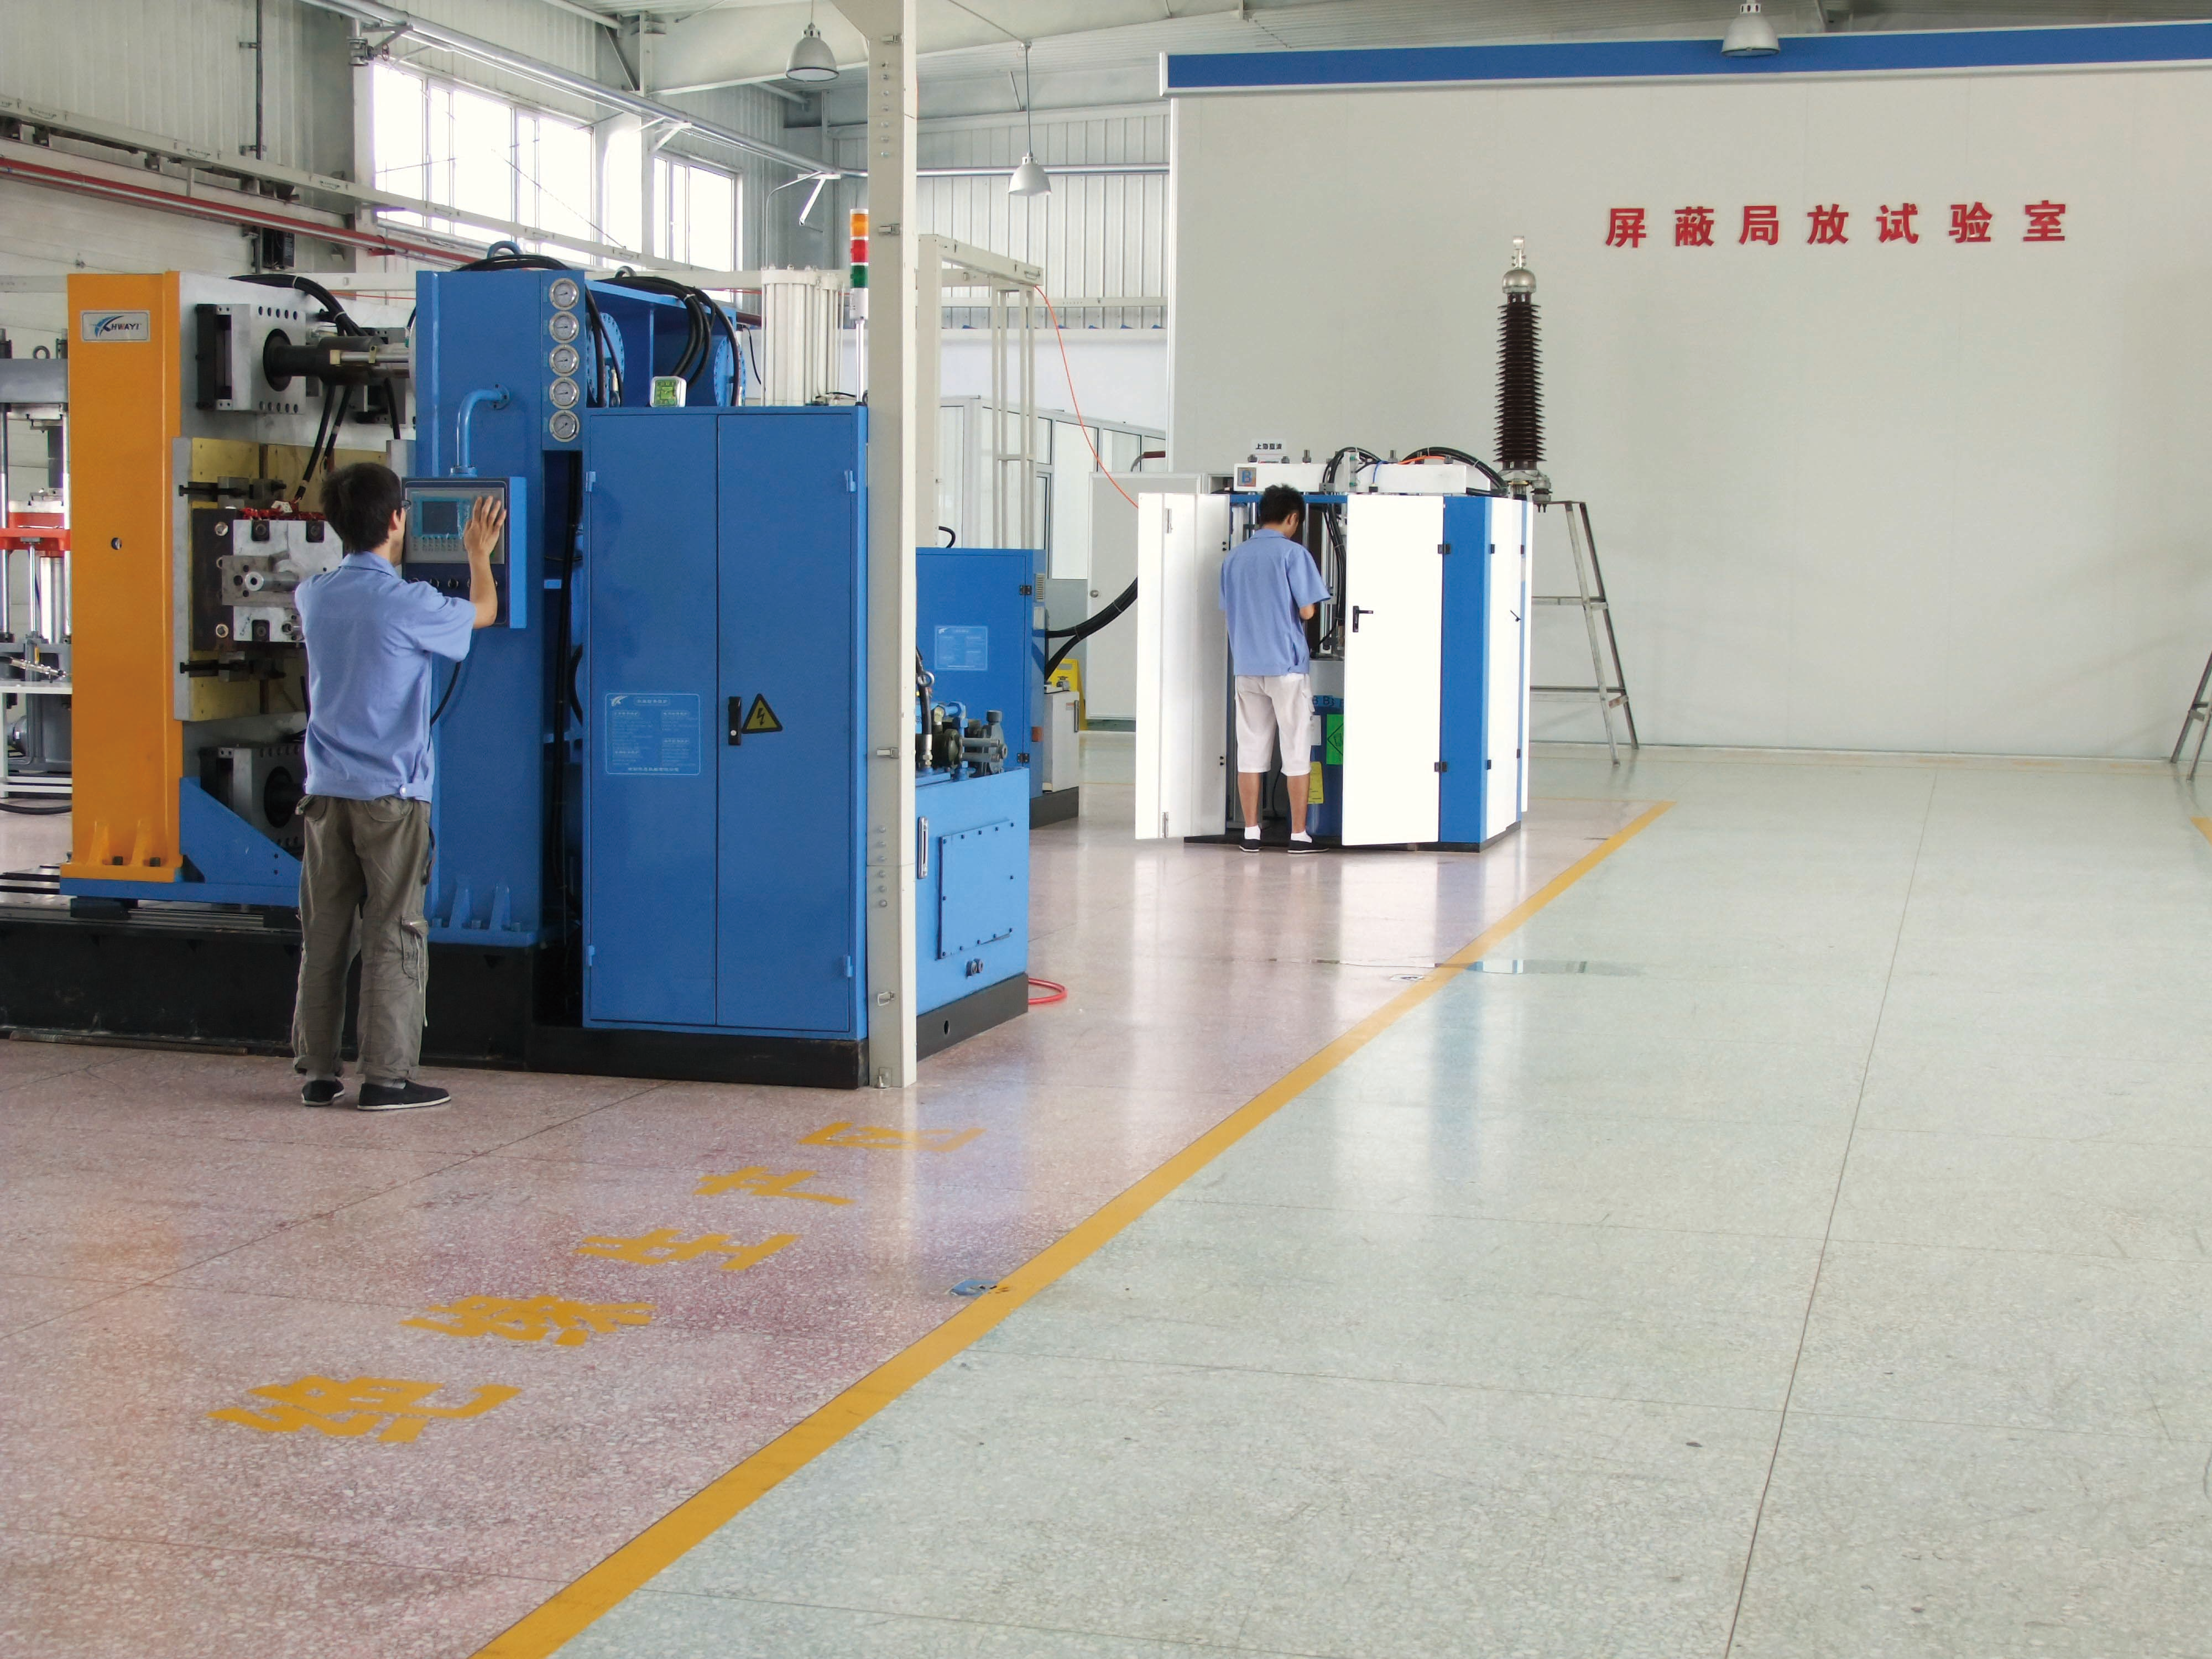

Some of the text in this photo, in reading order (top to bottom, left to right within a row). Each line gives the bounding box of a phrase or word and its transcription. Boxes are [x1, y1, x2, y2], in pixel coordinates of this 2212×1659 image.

[1605, 200, 2066, 248] 屏蔽局放试验室
[206, 1122, 985, 1442] 绝缘生产区
